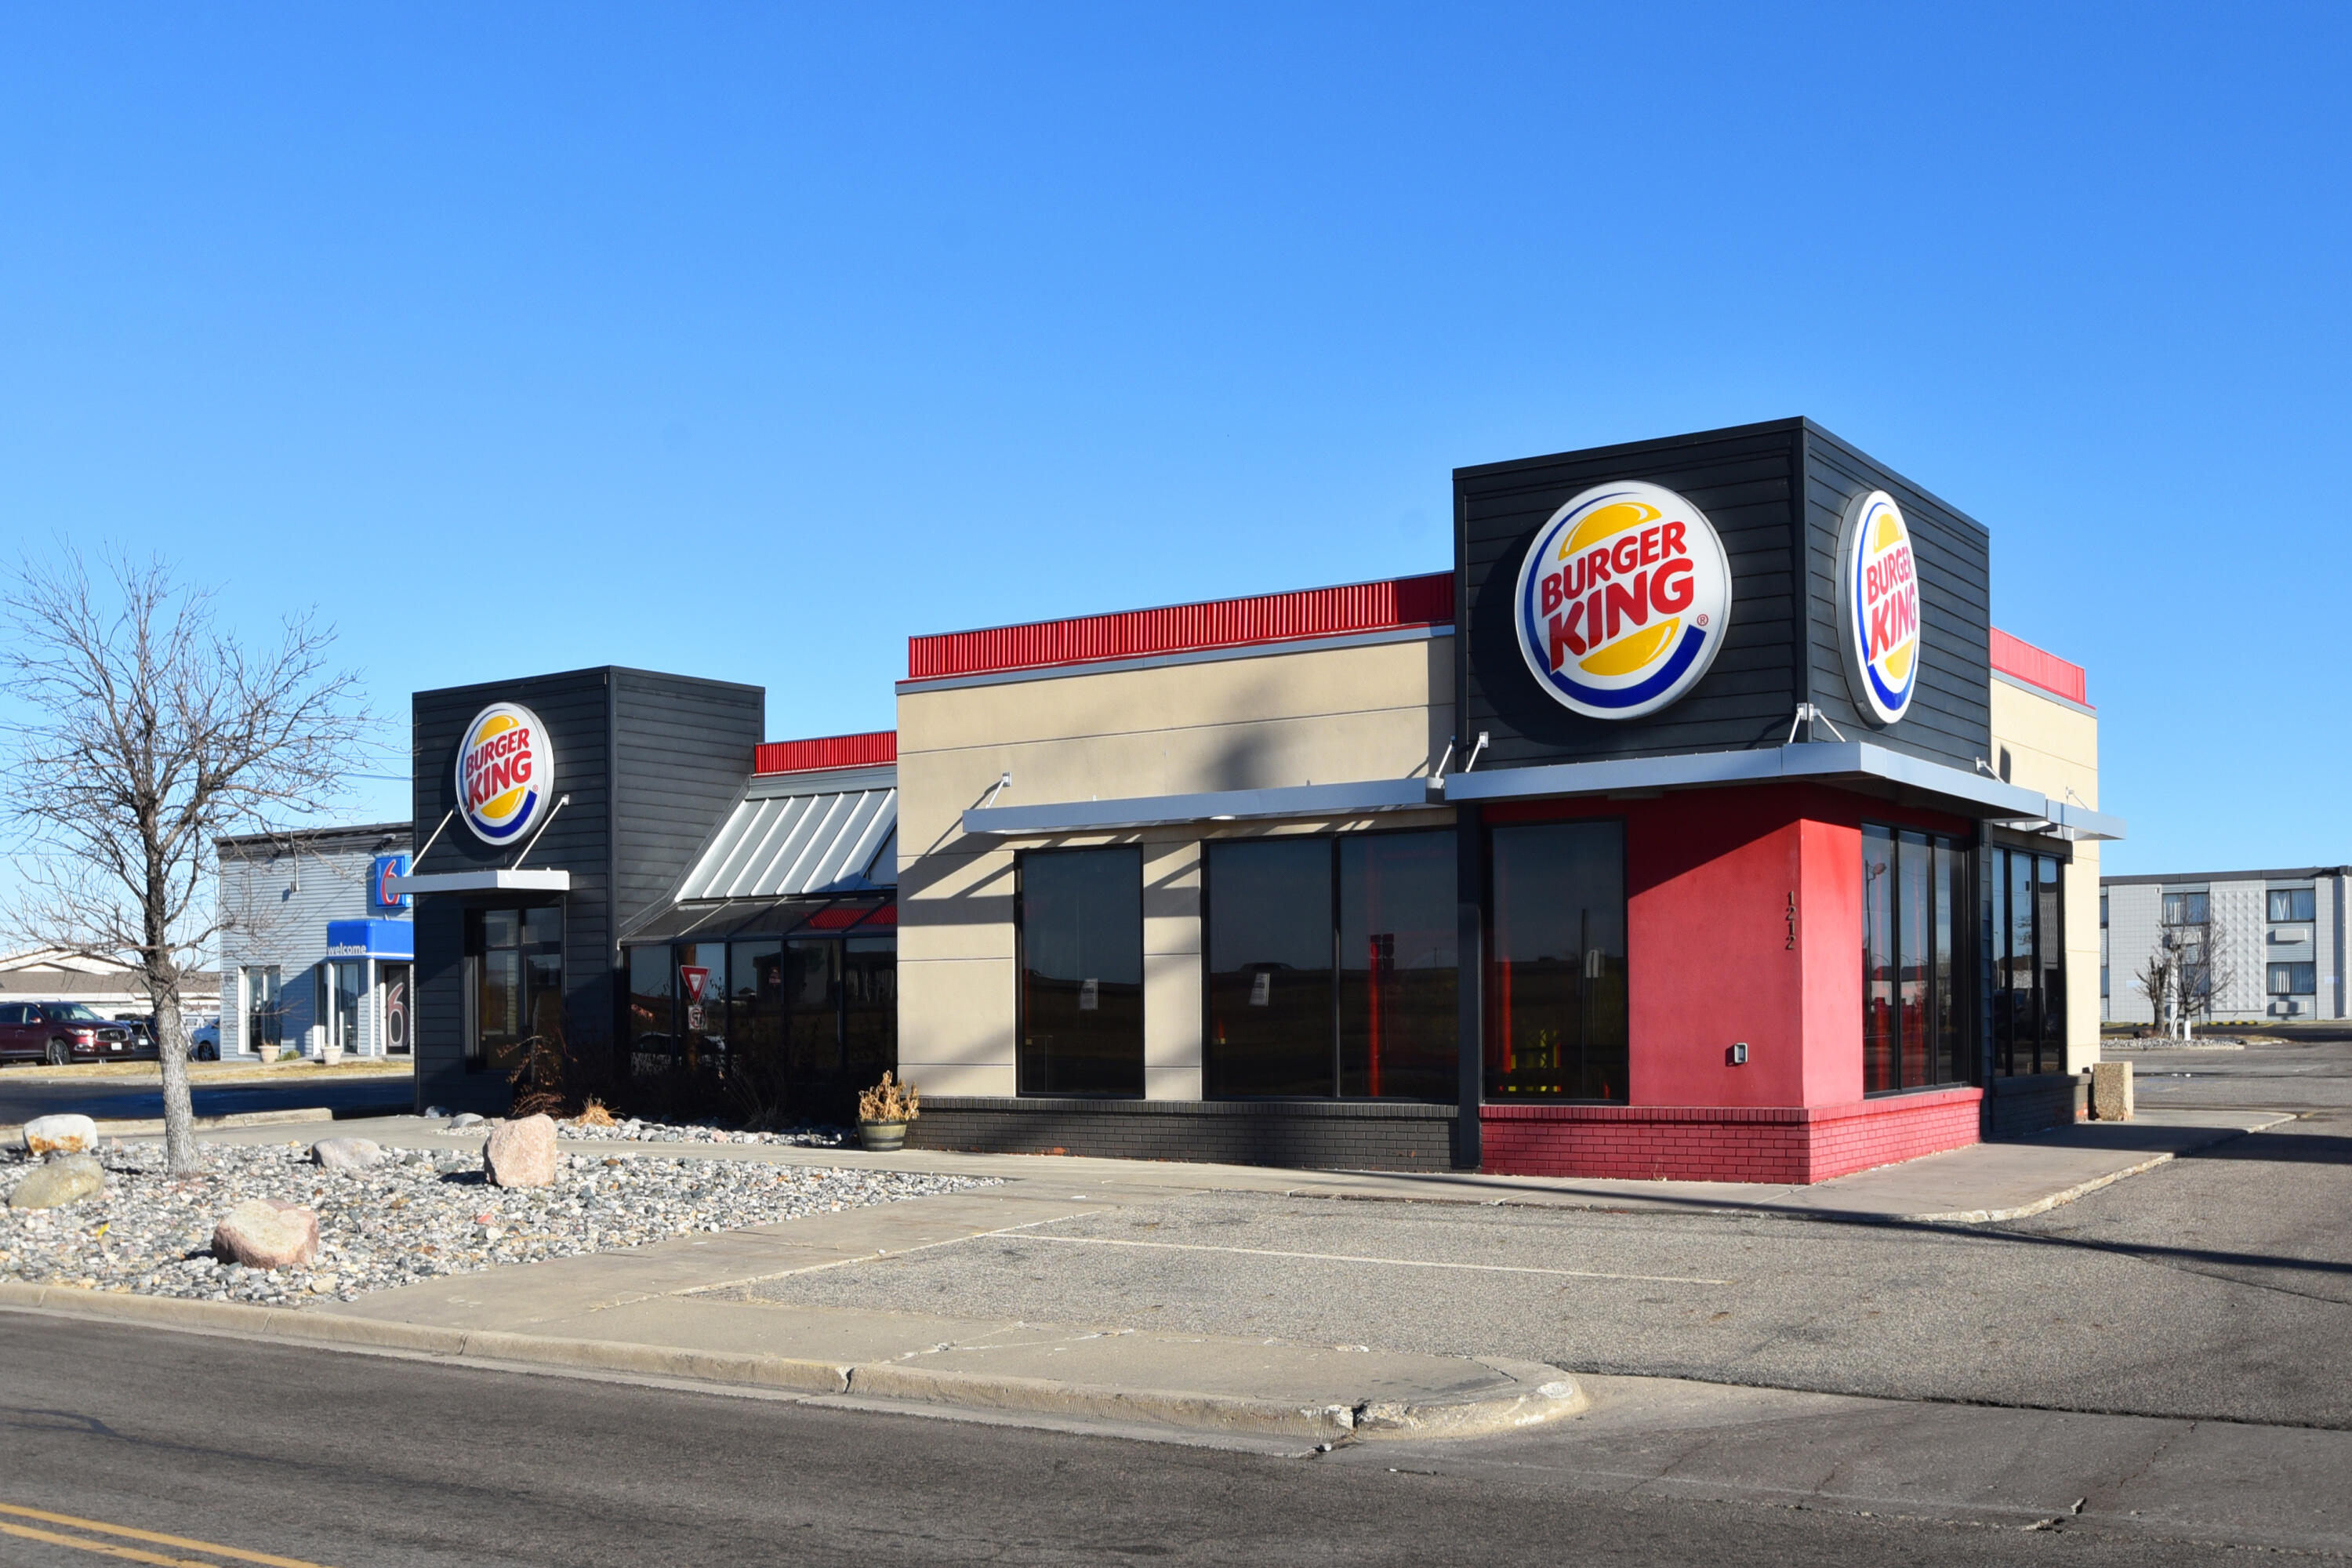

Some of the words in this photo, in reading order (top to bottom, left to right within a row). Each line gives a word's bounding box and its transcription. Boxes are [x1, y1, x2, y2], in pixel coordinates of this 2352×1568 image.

[1541, 521, 1687, 619] BURGER
[1548, 557, 1694, 672] KING
[1869, 582, 1916, 661] KING
[466, 728, 530, 781] BURGER
[468, 750, 532, 813] KING
[380, 859, 401, 906] 6
[327, 942, 367, 956] welcome
[1786, 891, 1796, 950] 1212
